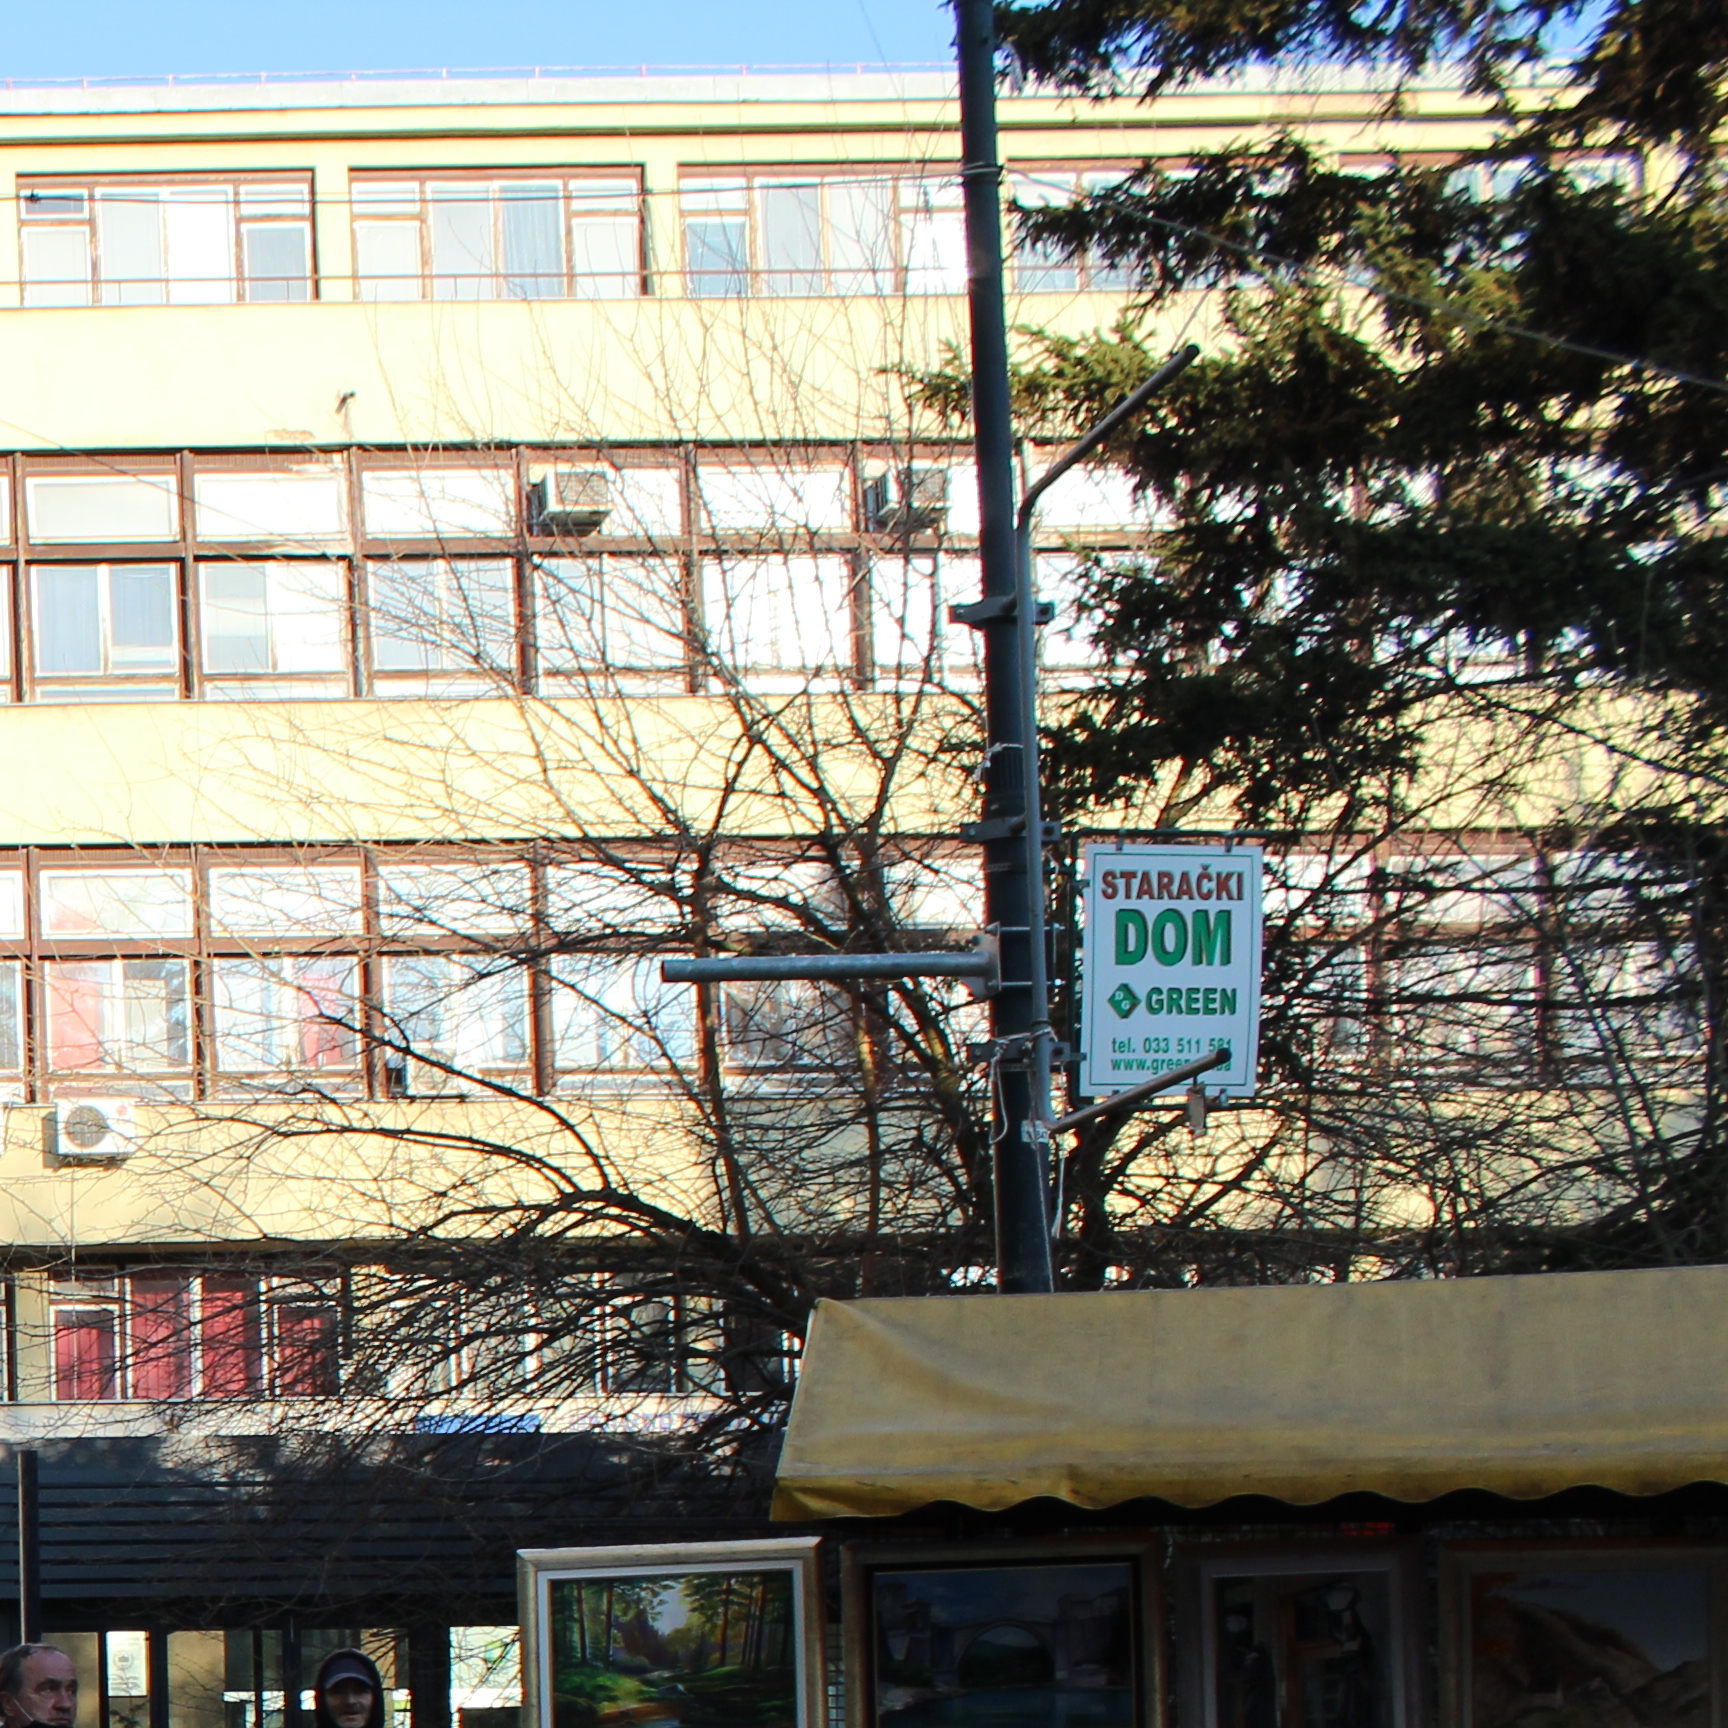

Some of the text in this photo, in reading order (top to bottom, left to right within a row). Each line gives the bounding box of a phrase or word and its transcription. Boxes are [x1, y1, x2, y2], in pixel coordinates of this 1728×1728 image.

[1101, 864, 1244, 900] STARAČKI
[1115, 908, 1232, 966] DOM
[1145, 987, 1237, 1015] GREEN
[1112, 1037, 1135, 1053] tel.
[1144, 1037, 1170, 1054] 033
[1177, 1037, 1200, 1053] 511
